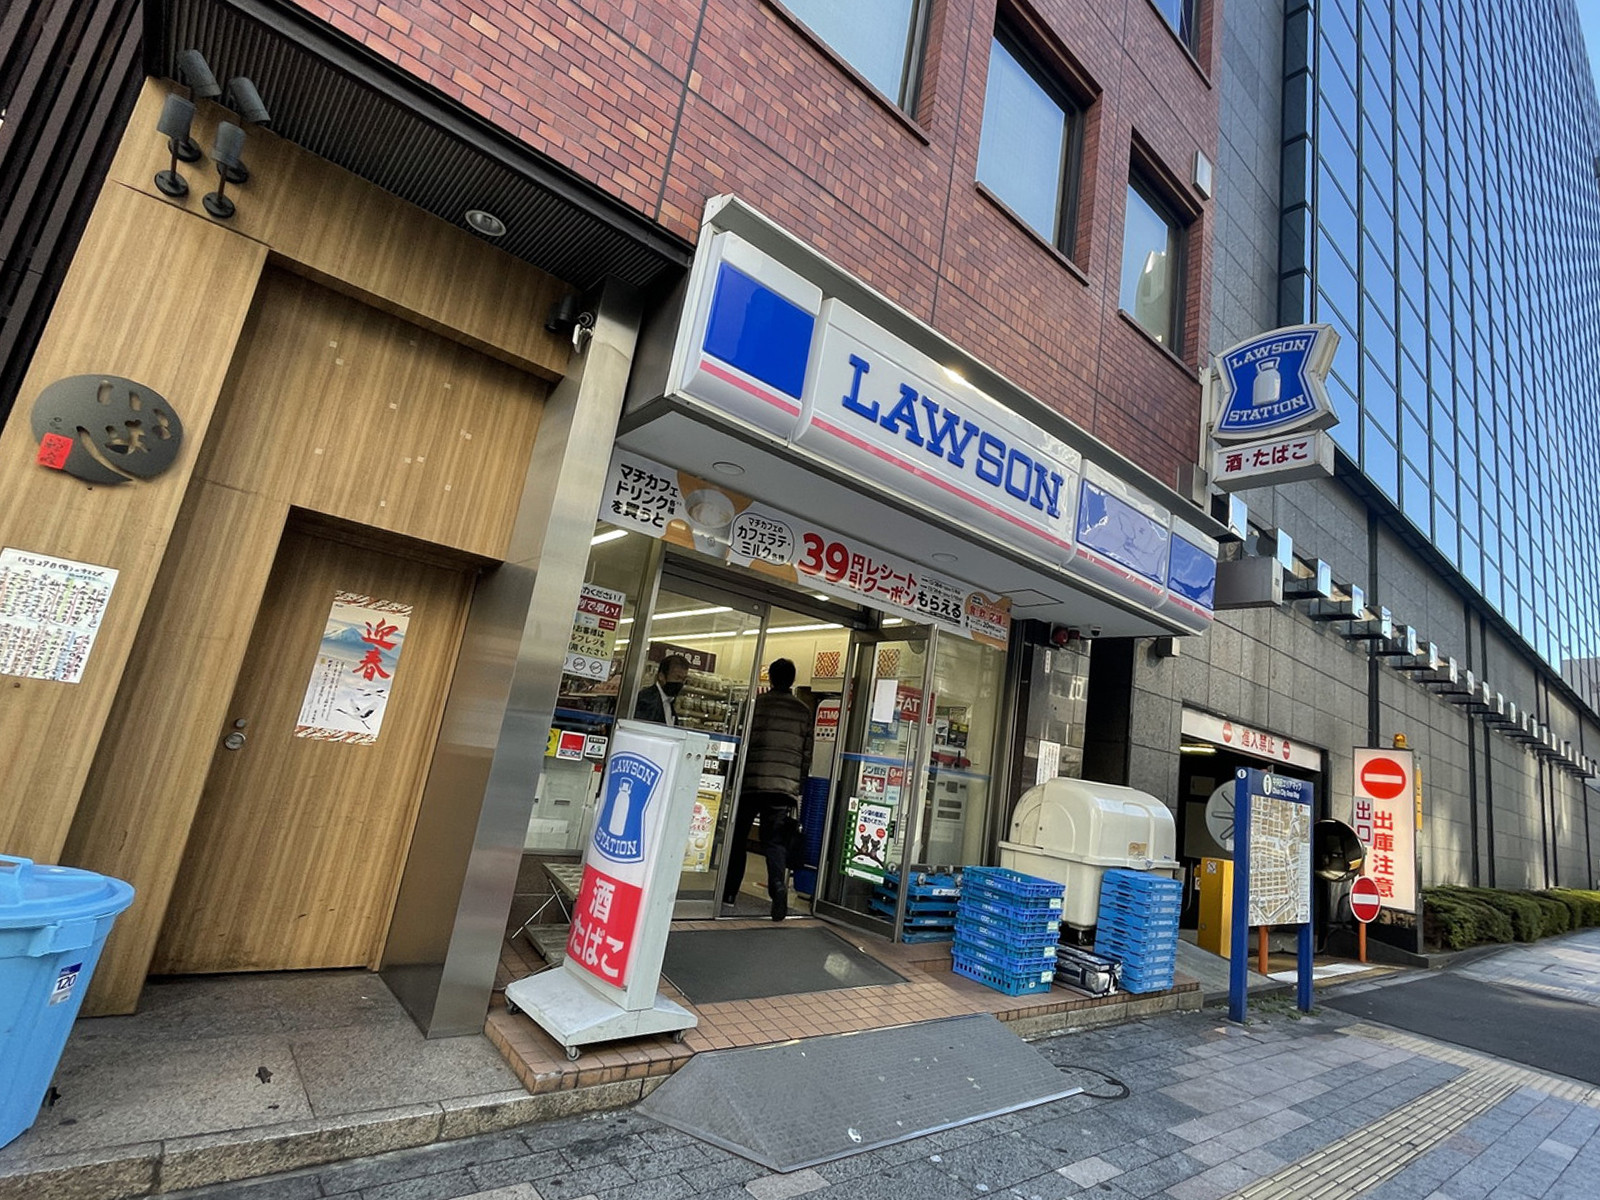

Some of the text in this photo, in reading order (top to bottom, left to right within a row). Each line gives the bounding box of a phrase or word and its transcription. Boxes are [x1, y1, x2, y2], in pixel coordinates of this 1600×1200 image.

[1231, 338, 1308, 369] LAWSON
[1228, 394, 1307, 423] STATION
[842, 353, 1064, 520] LAWSON
[1225, 442, 1308, 473] 酒・たばこ
[616, 481, 668, 511] ドリンク
[620, 463, 678, 499] マチカフェ
[611, 499, 666, 529] を買うと
[748, 516, 784, 534] マチカフェの
[741, 541, 773, 560] ミルク
[798, 532, 850, 583] 39
[917, 590, 962, 619] もらえる
[352, 617, 399, 682] 迎春
[1241, 728, 1276, 755] 進入禁止
[611, 758, 656, 786] LAWSON
[1356, 800, 1371, 843] 出口
[596, 827, 638, 856] STATION
[1373, 810, 1395, 899] 出庫注意
[589, 877, 616, 924] 酒
[569, 913, 624, 978] たばこ
[56, 973, 77, 992] 120
